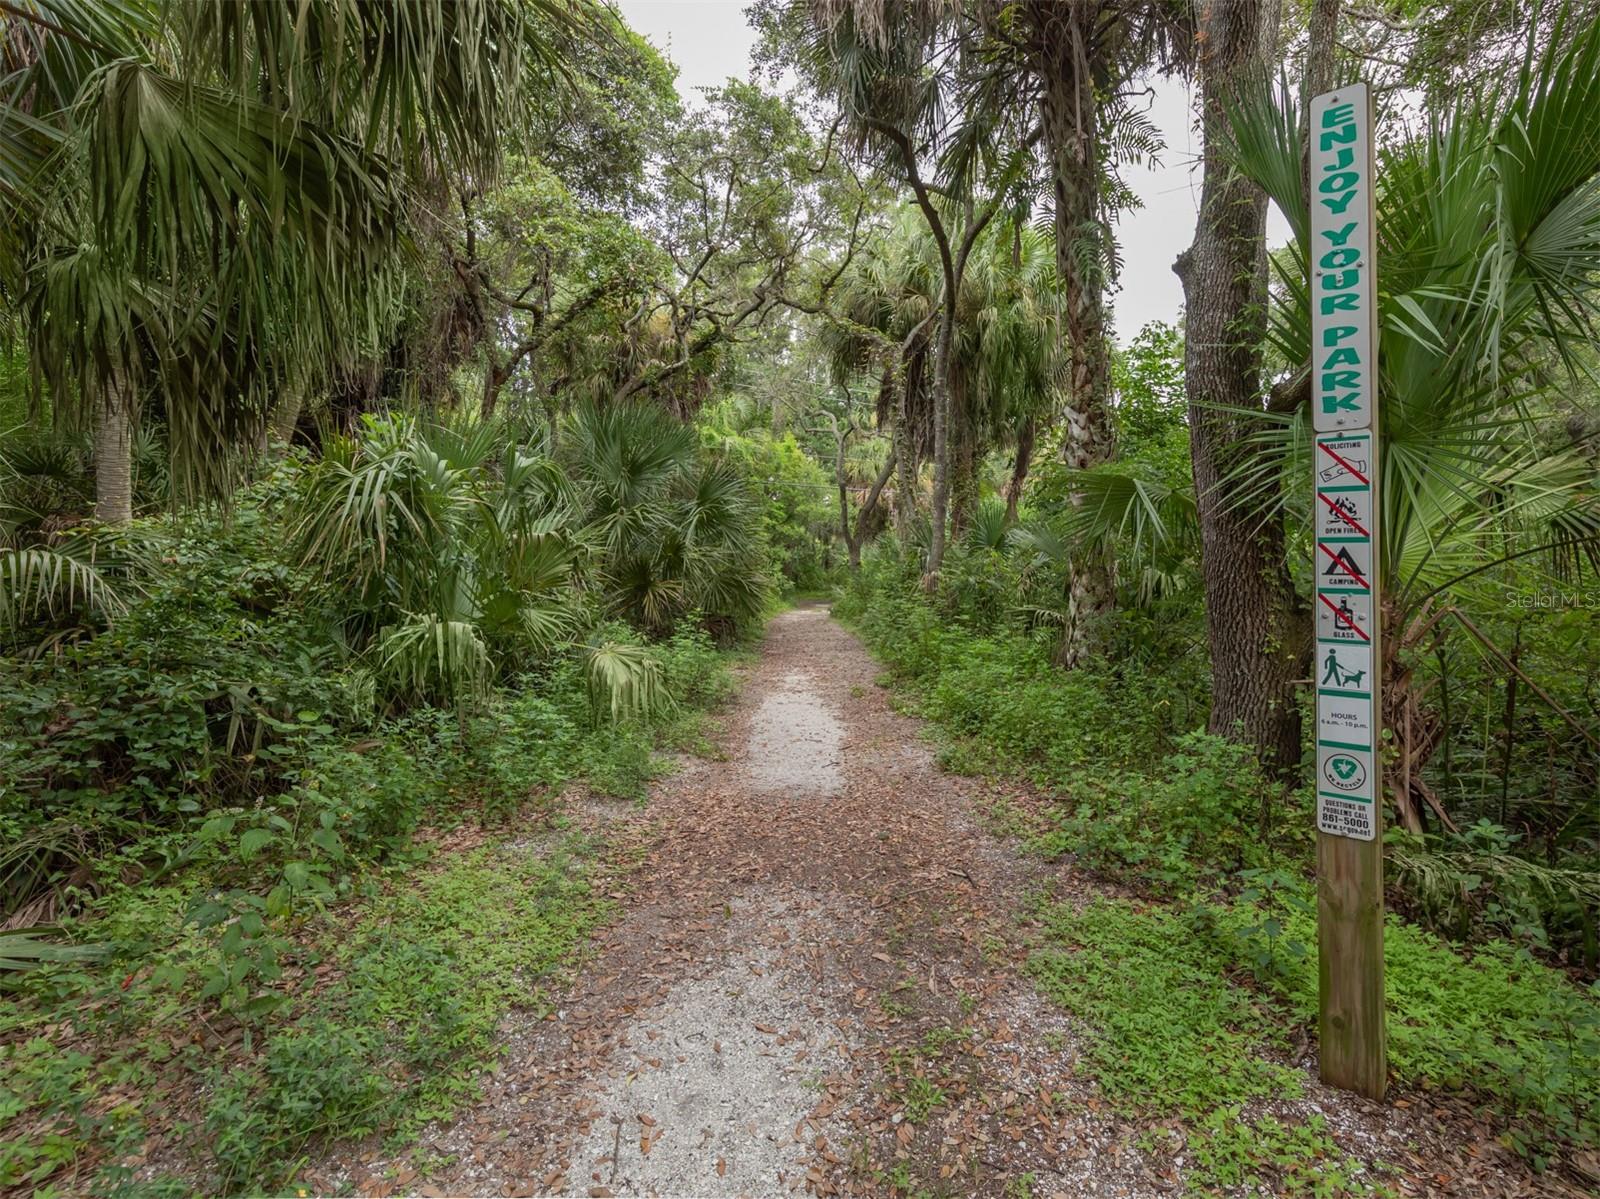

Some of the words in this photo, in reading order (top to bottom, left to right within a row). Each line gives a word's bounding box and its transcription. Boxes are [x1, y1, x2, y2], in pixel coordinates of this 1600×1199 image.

[1318, 103, 1360, 214] ENJOY
[1319, 222, 1360, 315] YOUR
[1321, 326, 1361, 413] PARK
[1331, 712, 1357, 720] HOURS
[1325, 799, 1356, 809] QUESTIONS
[1322, 813, 1369, 829] 861-5000
[1323, 806, 1352, 817] PROBLEMS
[1354, 811, 1368, 820] CALL
